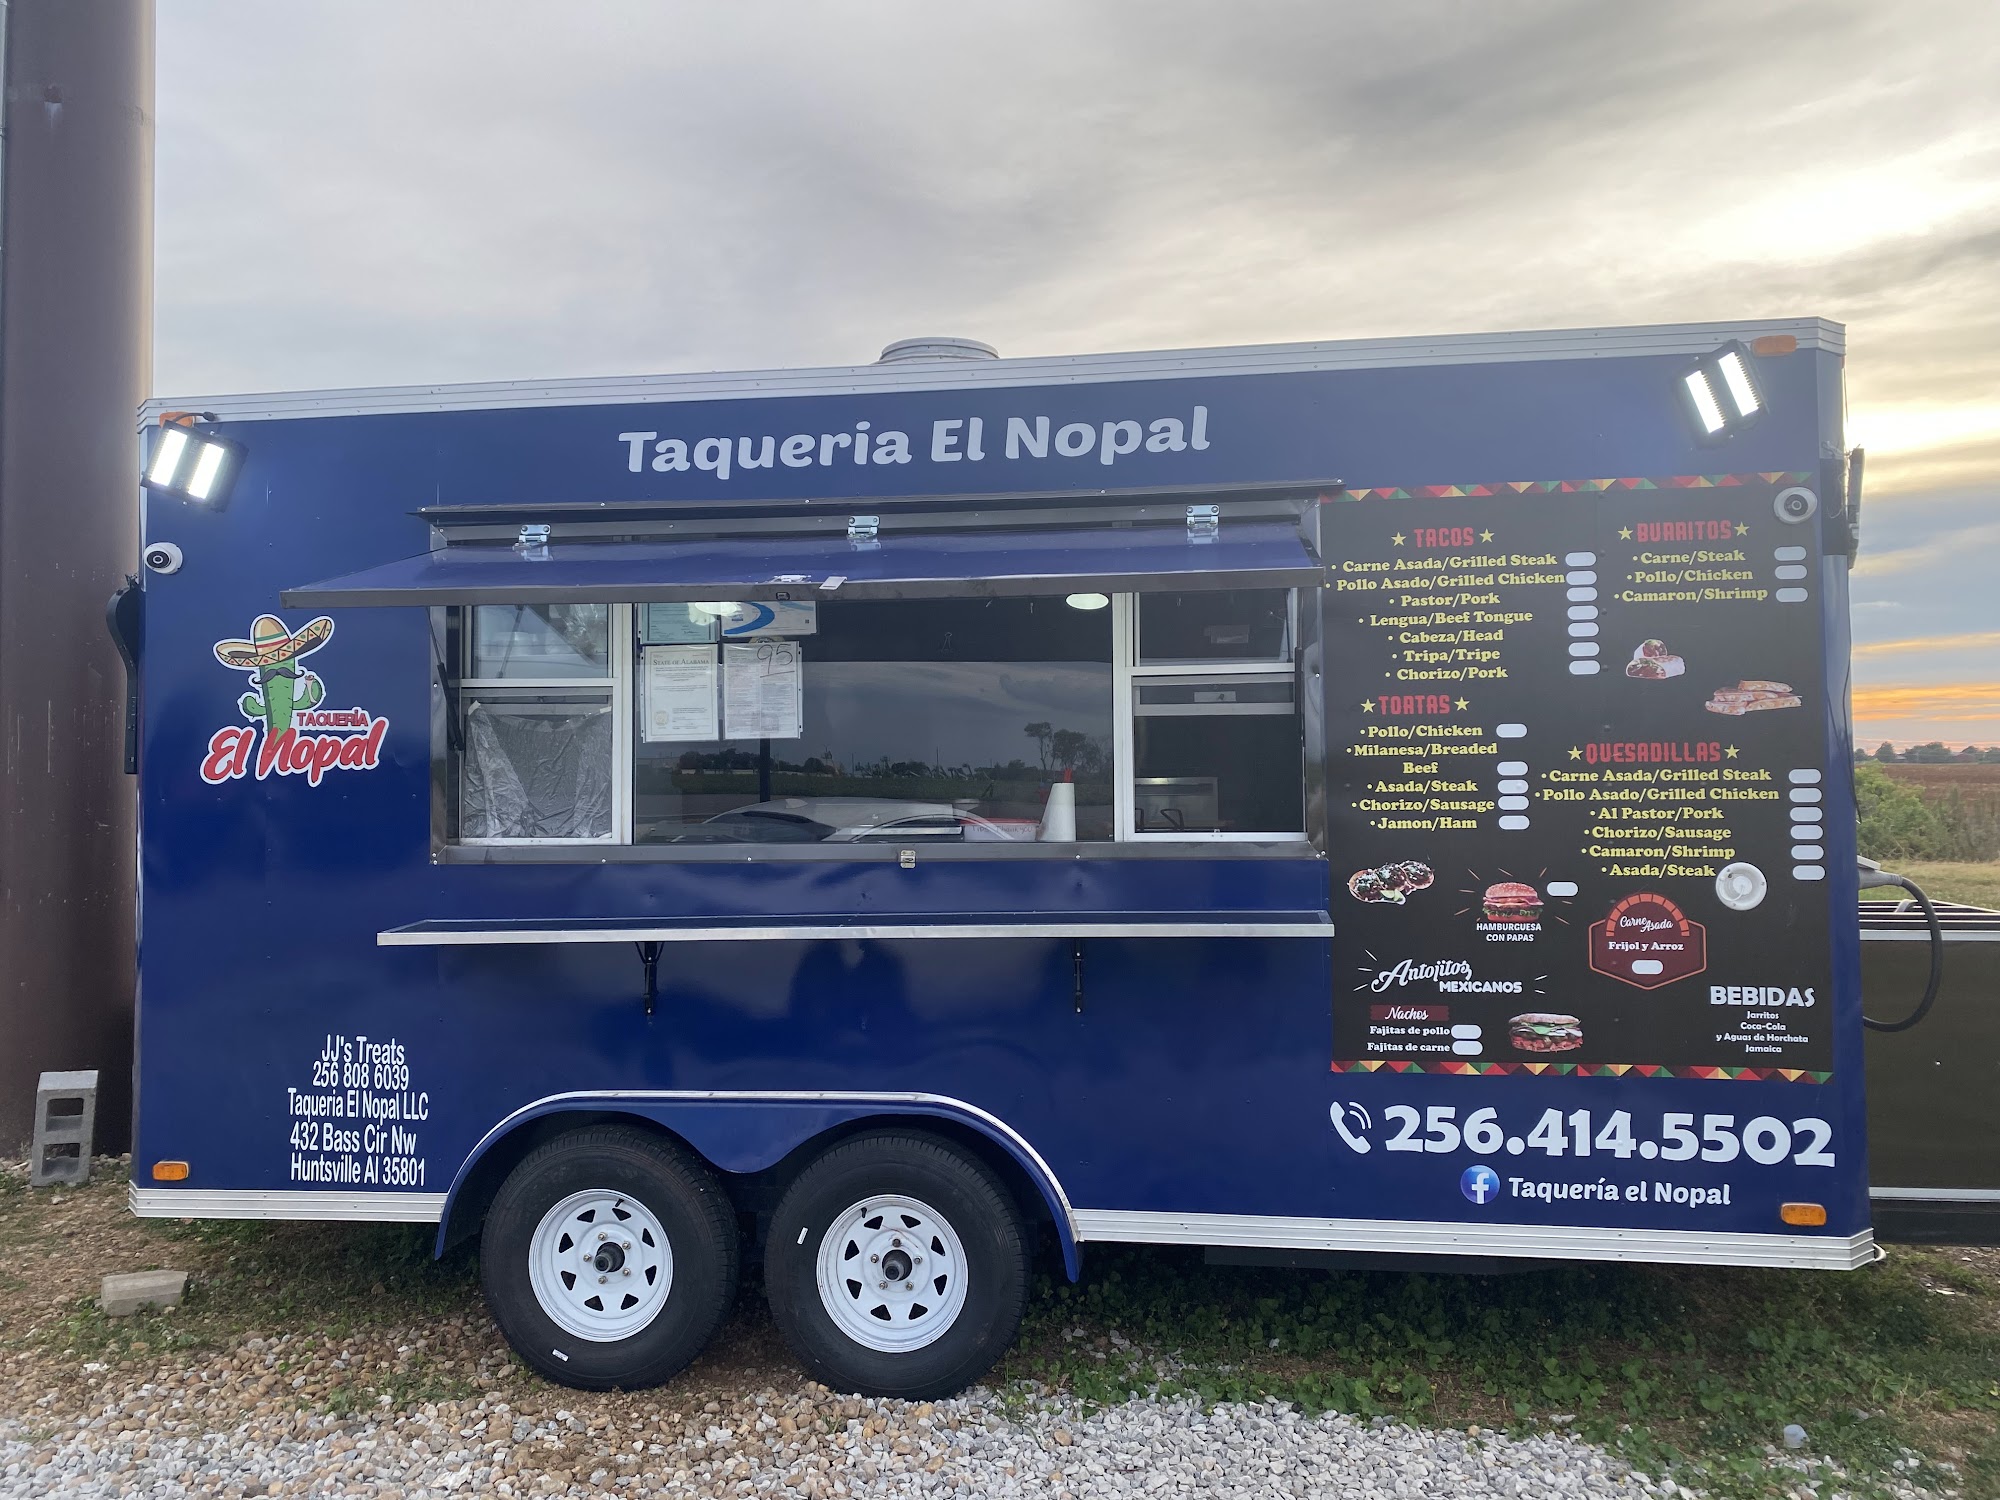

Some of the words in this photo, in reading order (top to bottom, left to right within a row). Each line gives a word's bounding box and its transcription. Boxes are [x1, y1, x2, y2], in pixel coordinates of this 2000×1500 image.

[618, 421, 912, 480] Taqueria
[931, 417, 985, 462] El
[1005, 406, 1210, 465] Nopal
[1413, 527, 1475, 548] TACOS
[1637, 520, 1732, 542] BURRITOS
[1343, 560, 1389, 572] Carne
[1394, 555, 1506, 571] Asada/Grilled
[1510, 554, 1557, 565] Steak
[1641, 550, 1746, 565] Carne/Steak
[1337, 578, 1377, 591] Pollo
[1381, 574, 1494, 590] Asado/Grilled
[1498, 572, 1565, 585] Chicken
[1635, 569, 1753, 584] Pollo/Chicken
[1401, 593, 1500, 607] Pastor/Pork
[1622, 588, 1768, 603] Camaron/Shrimp
[1370, 612, 1470, 627] Lengua/Beef
[1474, 611, 1533, 624] Tongue
[1400, 630, 1504, 644] Cabeza/Head
[757, 644, 793, 674] 95
[1403, 649, 1500, 663] Tripa/Tripe
[1397, 667, 1508, 681] Chorizo/Pork
[1378, 695, 1450, 715] TORTAS
[1368, 725, 1483, 739] Pollo/Chicken
[204, 729, 253, 780] El
[259, 720, 385, 783] Nopal
[1354, 743, 1497, 757] Milanesa/Breaded
[1586, 742, 1721, 765] QUESADILLAS
[1403, 762, 1439, 774] Beef
[1549, 770, 1599, 782] Carne
[1603, 769, 1719, 783] Asada/Grilled
[1723, 769, 1771, 781] Steak
[1375, 780, 1478, 794] Asada/Steak
[1543, 789, 1585, 801] Pollo
[1589, 788, 1706, 802] Asado/Grilled
[1710, 788, 1779, 800] Chicken
[1360, 799, 1495, 813] Chorizo/Sausage
[1598, 808, 1617, 819] Al
[1622, 807, 1724, 821] Pastor/Pork
[1377, 817, 1477, 831] Jamon/Ham
[1592, 826, 1732, 840] Chorizo/Sausage
[1589, 845, 1736, 859] Camaron/Shrimp
[1609, 864, 1716, 878] Asada/Steak
[1476, 923, 1542, 931] HAMBURGUESA
[1620, 916, 1647, 927] Carne
[1640, 919, 1673, 932] Asada
[1486, 934, 1505, 942] CON
[1507, 934, 1534, 942] PAPAS
[1608, 941, 1640, 952] Frijol
[1641, 943, 1650, 952] y
[1651, 942, 1684, 951] Arroz
[1371, 959, 1473, 993] Antojitos
[1439, 981, 1523, 994] MEXICANOS
[1710, 986, 1815, 1008] BEBIDAS
[1385, 1006, 1428, 1020] Nachos
[1747, 1011, 1779, 1020] Jarritos
[1369, 1026, 1405, 1037] Fajitas
[1408, 1026, 1420, 1035] de
[1423, 1027, 1450, 1037] pollo
[1740, 1022, 1786, 1031] Coca-Cola
[1716, 1034, 1722, 1042] y
[1724, 1033, 1752, 1042] Aguas
[1754, 1033, 1765, 1041] de
[1766, 1034, 1809, 1043] Horchata
[321, 1034, 352, 1062] JJ's
[356, 1036, 405, 1065] Treats
[1367, 1043, 1403, 1053] Fajitas
[1406, 1042, 1418, 1052] de
[1420, 1044, 1450, 1052] carne
[1745, 1044, 1782, 1053] Jamaica
[313, 1061, 339, 1087] 256
[343, 1063, 369, 1088] 808
[374, 1065, 409, 1090] 6039
[288, 1087, 344, 1123] Taqueria
[347, 1090, 359, 1118] El
[363, 1090, 399, 1126] Nopal
[403, 1092, 428, 1121] LLC
[290, 1121, 319, 1151] 432
[323, 1123, 360, 1153] Bass
[364, 1124, 388, 1154] Cir
[391, 1125, 417, 1155] Nw
[1384, 1104, 1835, 1168] 256.414.5502
[290, 1152, 360, 1183] Huntsville
[383, 1157, 425, 1186] 35801
[1509, 1176, 1619, 1204] Taquería
[1626, 1181, 1648, 1203] el
[1655, 1182, 1731, 1208] Nopal
